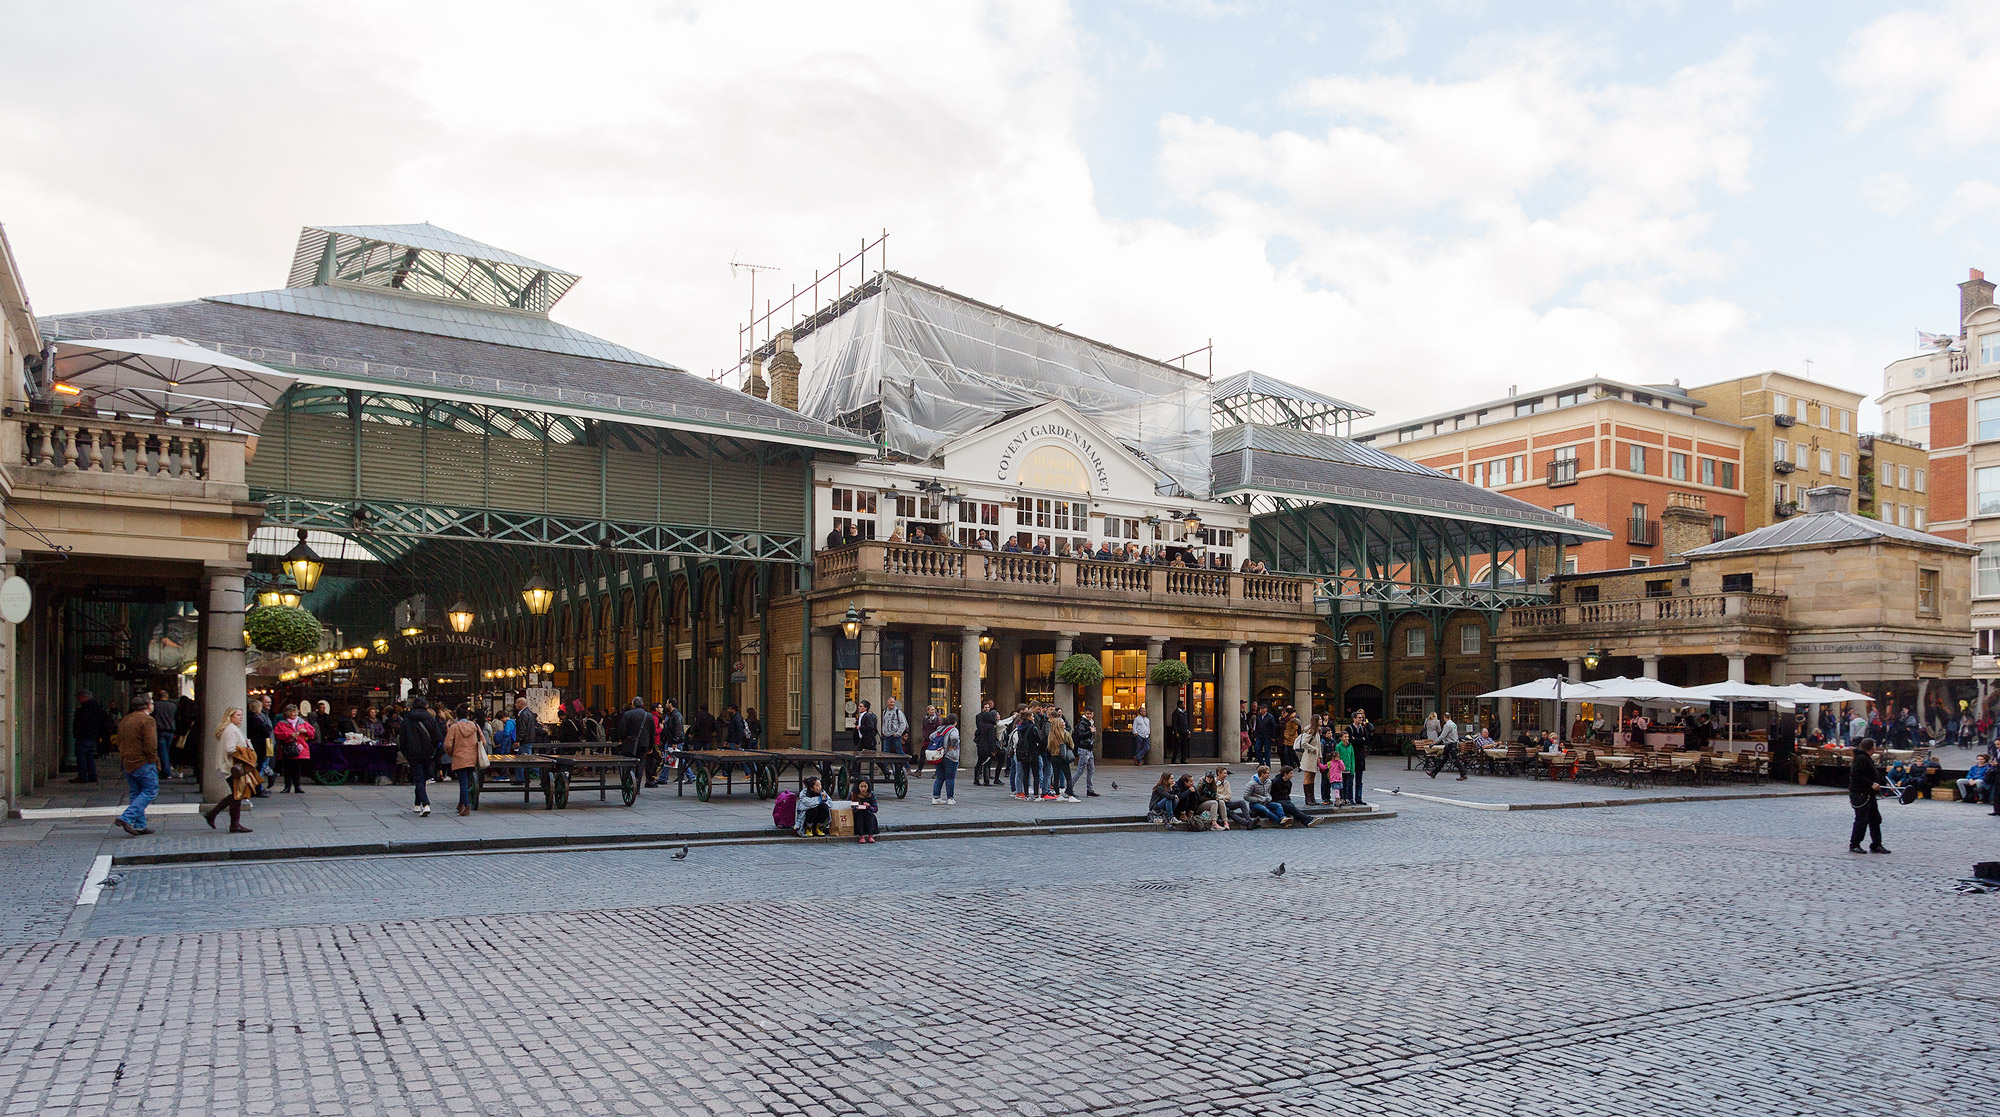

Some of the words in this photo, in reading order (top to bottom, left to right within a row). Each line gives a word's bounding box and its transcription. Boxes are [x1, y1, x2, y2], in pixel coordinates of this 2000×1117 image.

[997, 430, 1028, 481] COVENT
[1030, 424, 1082, 444] GARDEN
[1079, 439, 1109, 495] MARKET
[1034, 456, 1075, 471] PUNCH
[1046, 473, 1073, 486] JUDY
[405, 634, 440, 647] APPLE
[446, 634, 496, 649] MARKET
